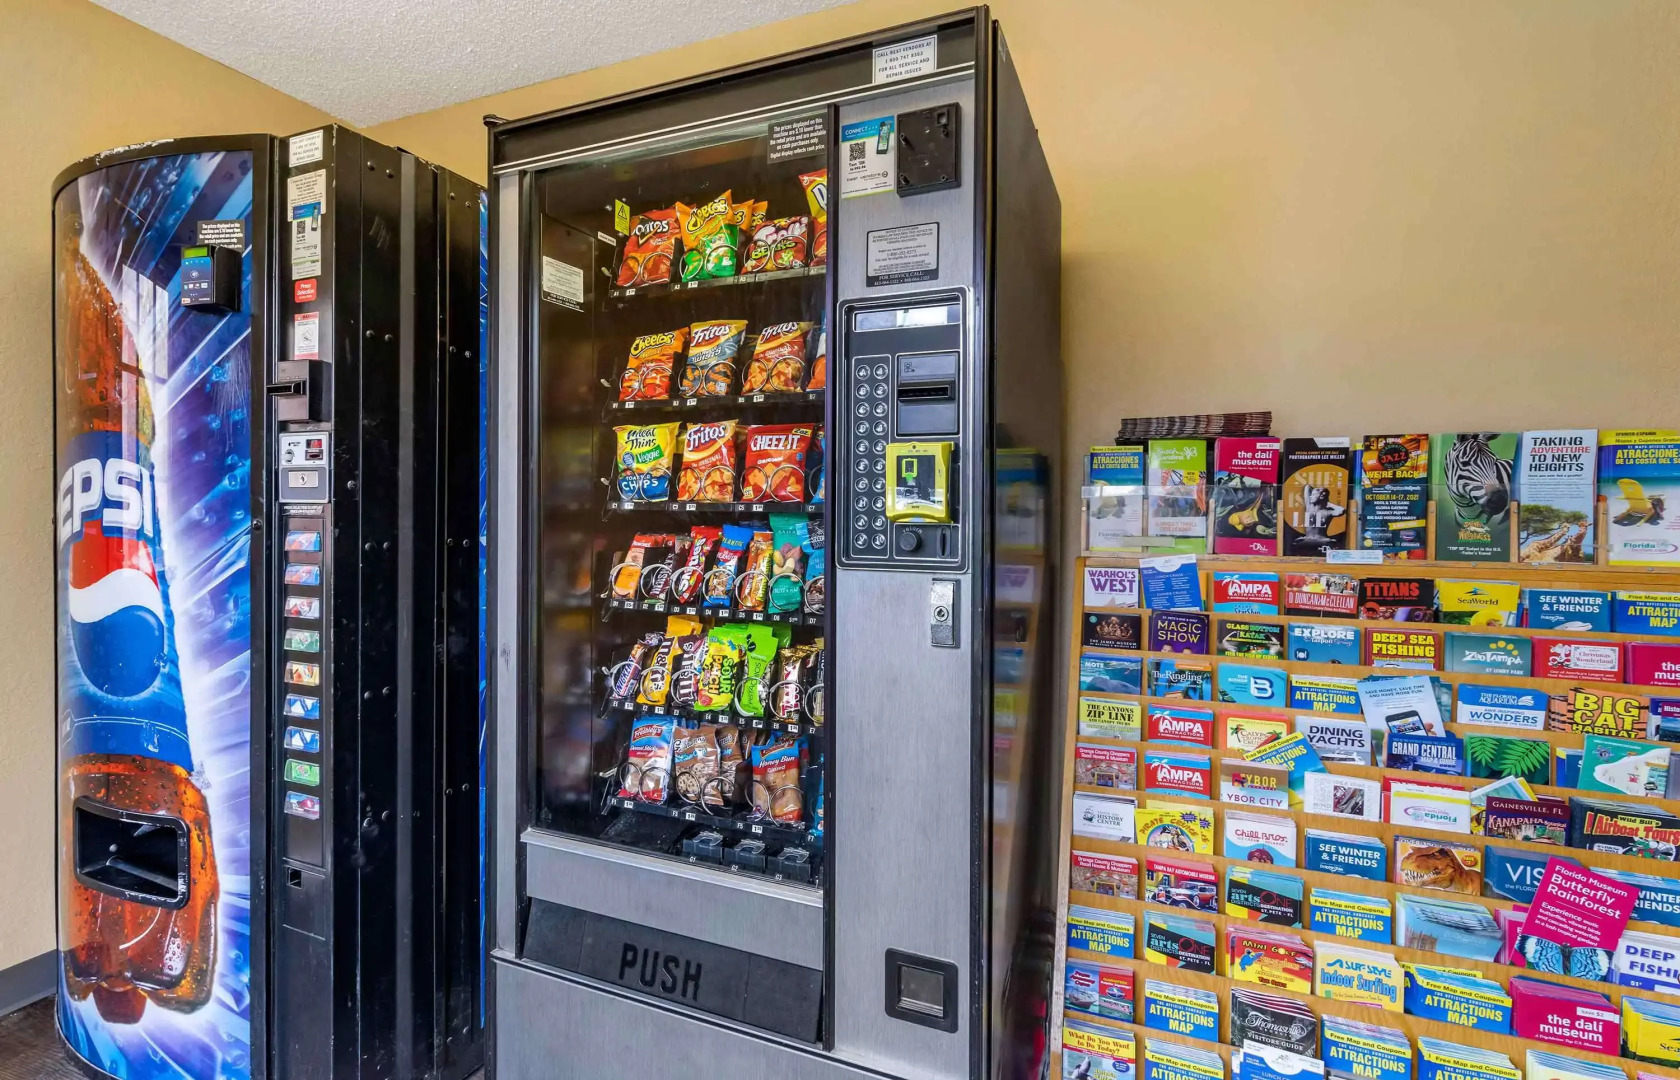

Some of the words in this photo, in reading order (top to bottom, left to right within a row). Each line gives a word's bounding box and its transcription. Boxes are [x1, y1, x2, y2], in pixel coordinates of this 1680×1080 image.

[899, 60, 918, 68] SERVICE
[904, 66, 922, 75] ISSUES
[691, 322, 731, 348] Fritos
[630, 332, 674, 359] Cheetos
[625, 438, 656, 451] Thins
[687, 428, 726, 456] Fritos
[1532, 437, 1583, 447] TAKING
[636, 449, 660, 463] Veggie
[1238, 450, 1253, 458] the
[1530, 446, 1590, 454] ADVENTURE
[1093, 456, 1139, 464] ATRACCIONES
[1380, 452, 1406, 464] JAZZ
[1530, 454, 1546, 462] TO
[1552, 454, 1581, 462] NEW
[1366, 470, 1394, 478] WE'RE
[1396, 470, 1420, 478] BACK
[1529, 462, 1584, 472] HEIGHTS
[1088, 570, 1136, 579] WARHOL'S
[1091, 579, 1136, 594] WEST
[1458, 596, 1499, 606] SeaWorld
[1540, 595, 1558, 604] SEE
[1558, 596, 1602, 605] WINTER
[1551, 604, 1600, 613] FRIENDS
[1158, 620, 1202, 634] MAGIC
[1650, 617, 1678, 628] MAP
[1158, 630, 1200, 644] SHOW
[1294, 628, 1354, 640] EXPLORE
[1372, 632, 1407, 644] DEEP
[1410, 635, 1434, 646] SEA
[1372, 644, 1435, 658] FISHING
[720, 657, 733, 694] SOUR
[1295, 690, 1356, 704] ATTRACTIONS
[1574, 692, 1640, 716] BIG
[1102, 706, 1134, 714] CANYONS
[1313, 701, 1336, 712] MAP
[1087, 710, 1104, 721] ZIP
[1108, 711, 1134, 722] LINE
[1470, 710, 1538, 724] WONDERS
[1573, 710, 1638, 732] CAT
[1309, 725, 1364, 739] DINING
[1572, 724, 1638, 739] HABITAT
[1306, 735, 1366, 748] YACHTS
[1392, 741, 1419, 757] GRAND
[1420, 744, 1457, 760] CENTRAL
[759, 758, 779, 768] Honey
[1246, 773, 1277, 788] YBOR
[1227, 793, 1255, 804] YBOR
[1259, 796, 1282, 807] CITY
[1097, 814, 1124, 823] HISTORY
[1552, 807, 1563, 816] FL
[1096, 818, 1122, 827] CENTER
[1140, 816, 1165, 835] PIRATE
[1486, 814, 1545, 830] KANAPAHA
[1618, 815, 1634, 824] Wild
[1235, 828, 1262, 840] Chill
[1593, 814, 1640, 839] Airboat
[1644, 824, 1680, 847] Tours
[1319, 843, 1336, 854] SEE
[1338, 846, 1381, 860] WINTER
[1321, 852, 1330, 861] &
[1332, 854, 1378, 868] FRIENDS
[1554, 864, 1588, 882] Florida
[1588, 880, 1628, 898] Museum
[1551, 872, 1616, 906] Butterfly
[1231, 893, 1260, 903] arts
[1546, 884, 1622, 920] Rainforest
[1260, 904, 1294, 913] DESTINATION
[1330, 901, 1343, 909] Map
[1357, 906, 1385, 915] Coupons
[1541, 901, 1582, 922] Experience
[1582, 917, 1600, 929] exotic
[1314, 910, 1384, 932] ATTRACTIONS
[1072, 929, 1130, 948] ATTRACTIONS
[1336, 925, 1363, 939] MAP
[1088, 942, 1112, 954] MAP
[1150, 938, 1179, 951] arts
[1242, 940, 1268, 950] MINI
[1625, 944, 1676, 963] DEEP
[618, 942, 702, 1002] PUSH
[1320, 970, 1355, 988] Indoor
[1356, 974, 1398, 1004] Surfing
[1426, 982, 1440, 991] Free
[1443, 985, 1458, 995] Map
[1474, 992, 1506, 1005] Coupons
[1424, 994, 1504, 1022] ATTRACTIONS
[1596, 1010, 1604, 1018] $2
[1150, 1004, 1214, 1029] ATTRACTIONS
[1447, 1010, 1478, 1028] MAP
[1547, 1014, 1571, 1027] the
[1575, 1018, 1604, 1033] dalí
[1168, 1020, 1194, 1034] MAP
[1246, 1011, 1306, 1040] Thomasville
[1068, 1031, 1085, 1041] What
[1086, 1034, 1096, 1042] Do
[1098, 1036, 1110, 1046] You
[1112, 1039, 1130, 1050] Want
[1540, 1024, 1604, 1043] museum
[1248, 1032, 1283, 1048] VISITORS
[1284, 1040, 1304, 1052] GUIDE
[1097, 1044, 1121, 1055] Today?
[1330, 1046, 1406, 1074] ATTRACTIONS
[1352, 1063, 1382, 1080] MAP
